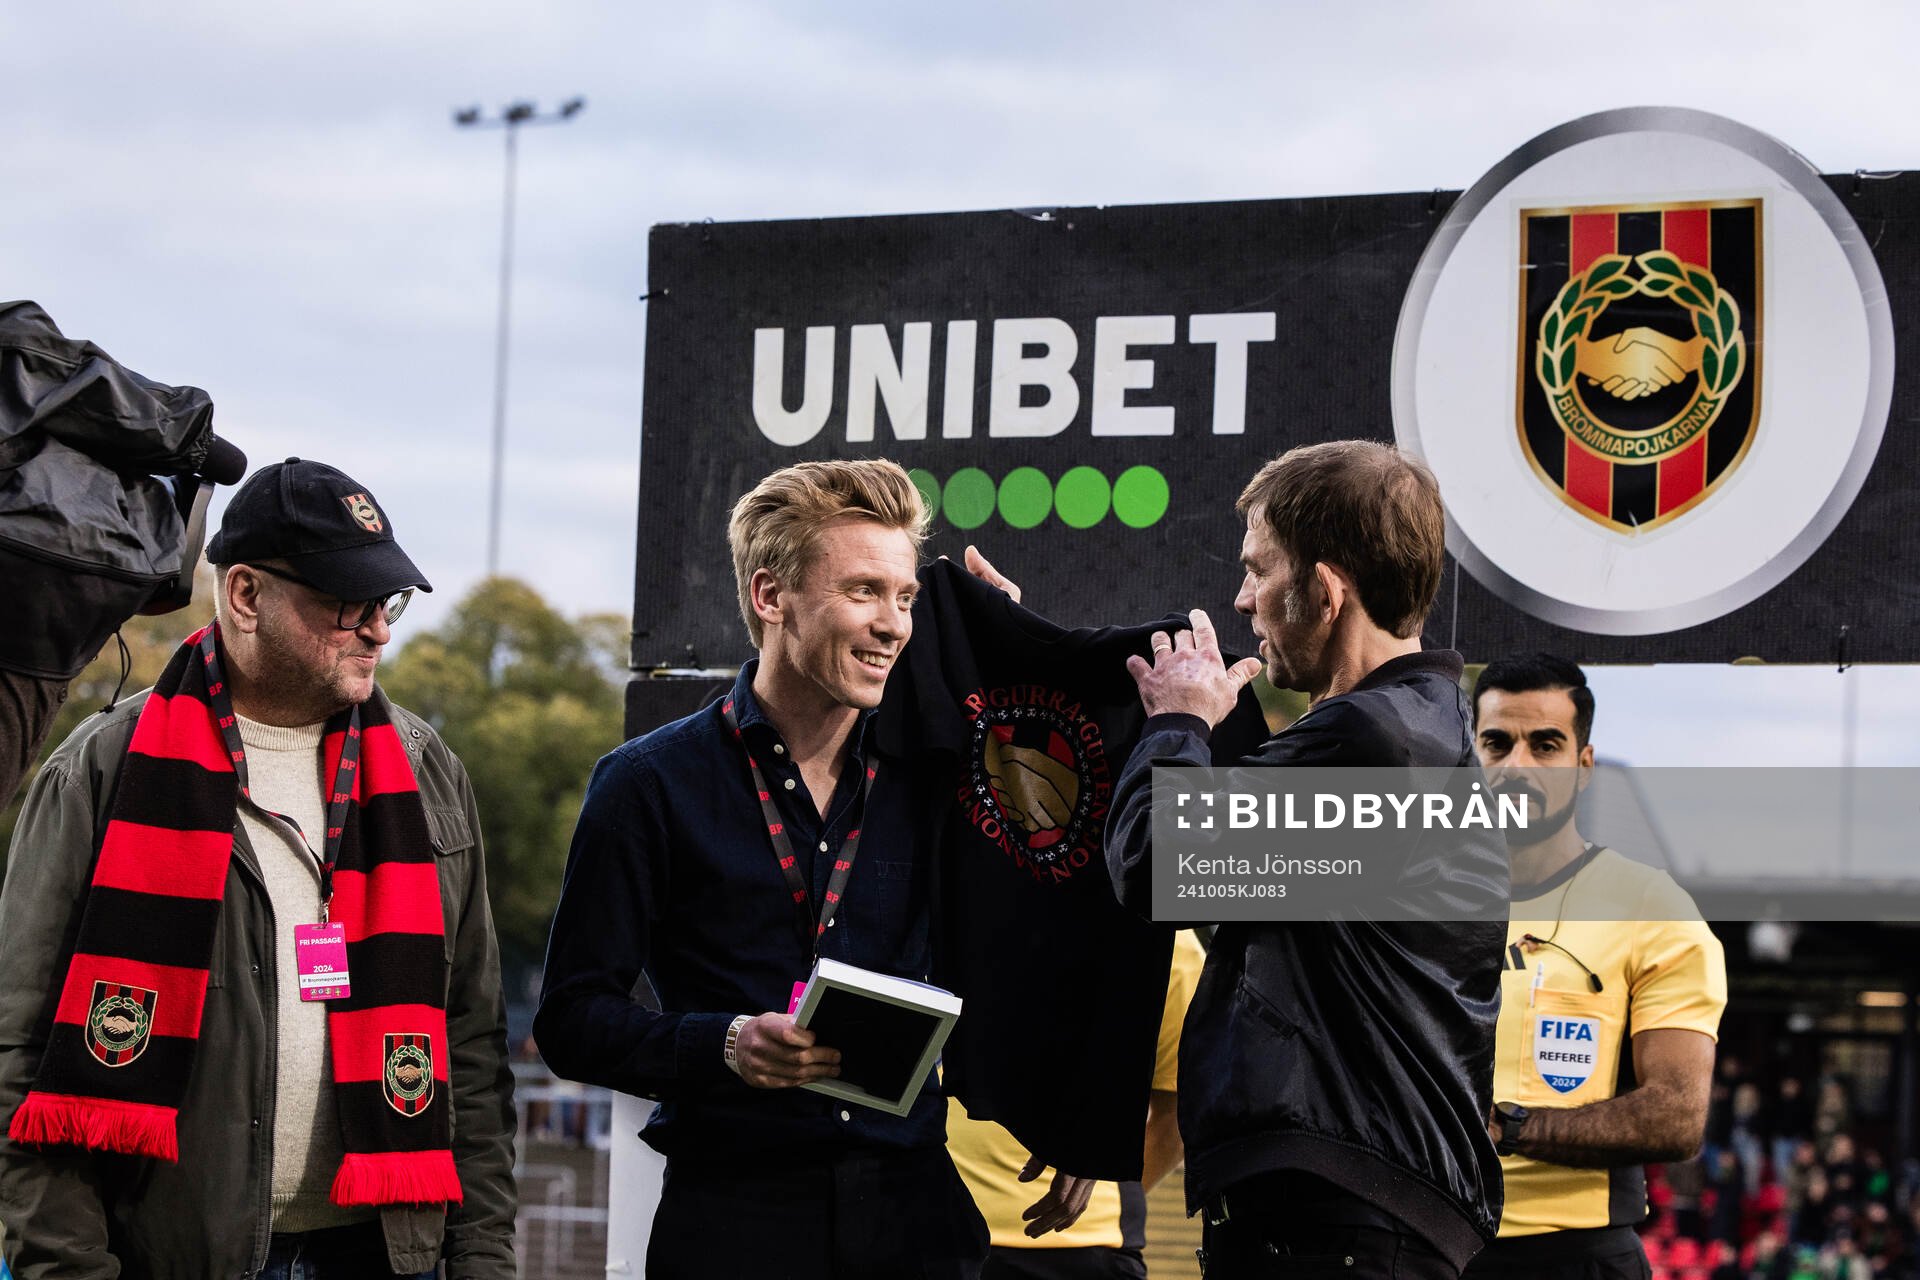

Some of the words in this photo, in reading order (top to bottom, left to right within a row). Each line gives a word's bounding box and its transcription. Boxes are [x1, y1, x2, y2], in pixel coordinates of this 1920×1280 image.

[752, 312, 1276, 446] UNIBET
[1557, 397, 1714, 456] BROMMAPOJKARNA
[209, 682, 223, 697] BP
[989, 684, 1083, 721] GURRA
[219, 715, 235, 729] BP
[231, 751, 245, 763] BP
[341, 758, 356, 771] BP
[1079, 721, 1112, 821] GUTEN
[333, 792, 350, 804] BP
[328, 827, 343, 838] BP
[768, 823, 783, 836] BP
[780, 855, 796, 870] BP
[834, 860, 851, 872] BP
[825, 891, 840, 904] BP
[310, 937, 342, 945] PASSAGE
[313, 965, 333, 973] 2024
[1541, 1020, 1593, 1042] FIFA
[1539, 1051, 1592, 1064] REFEREE
[1552, 1076, 1576, 1088] 2024
